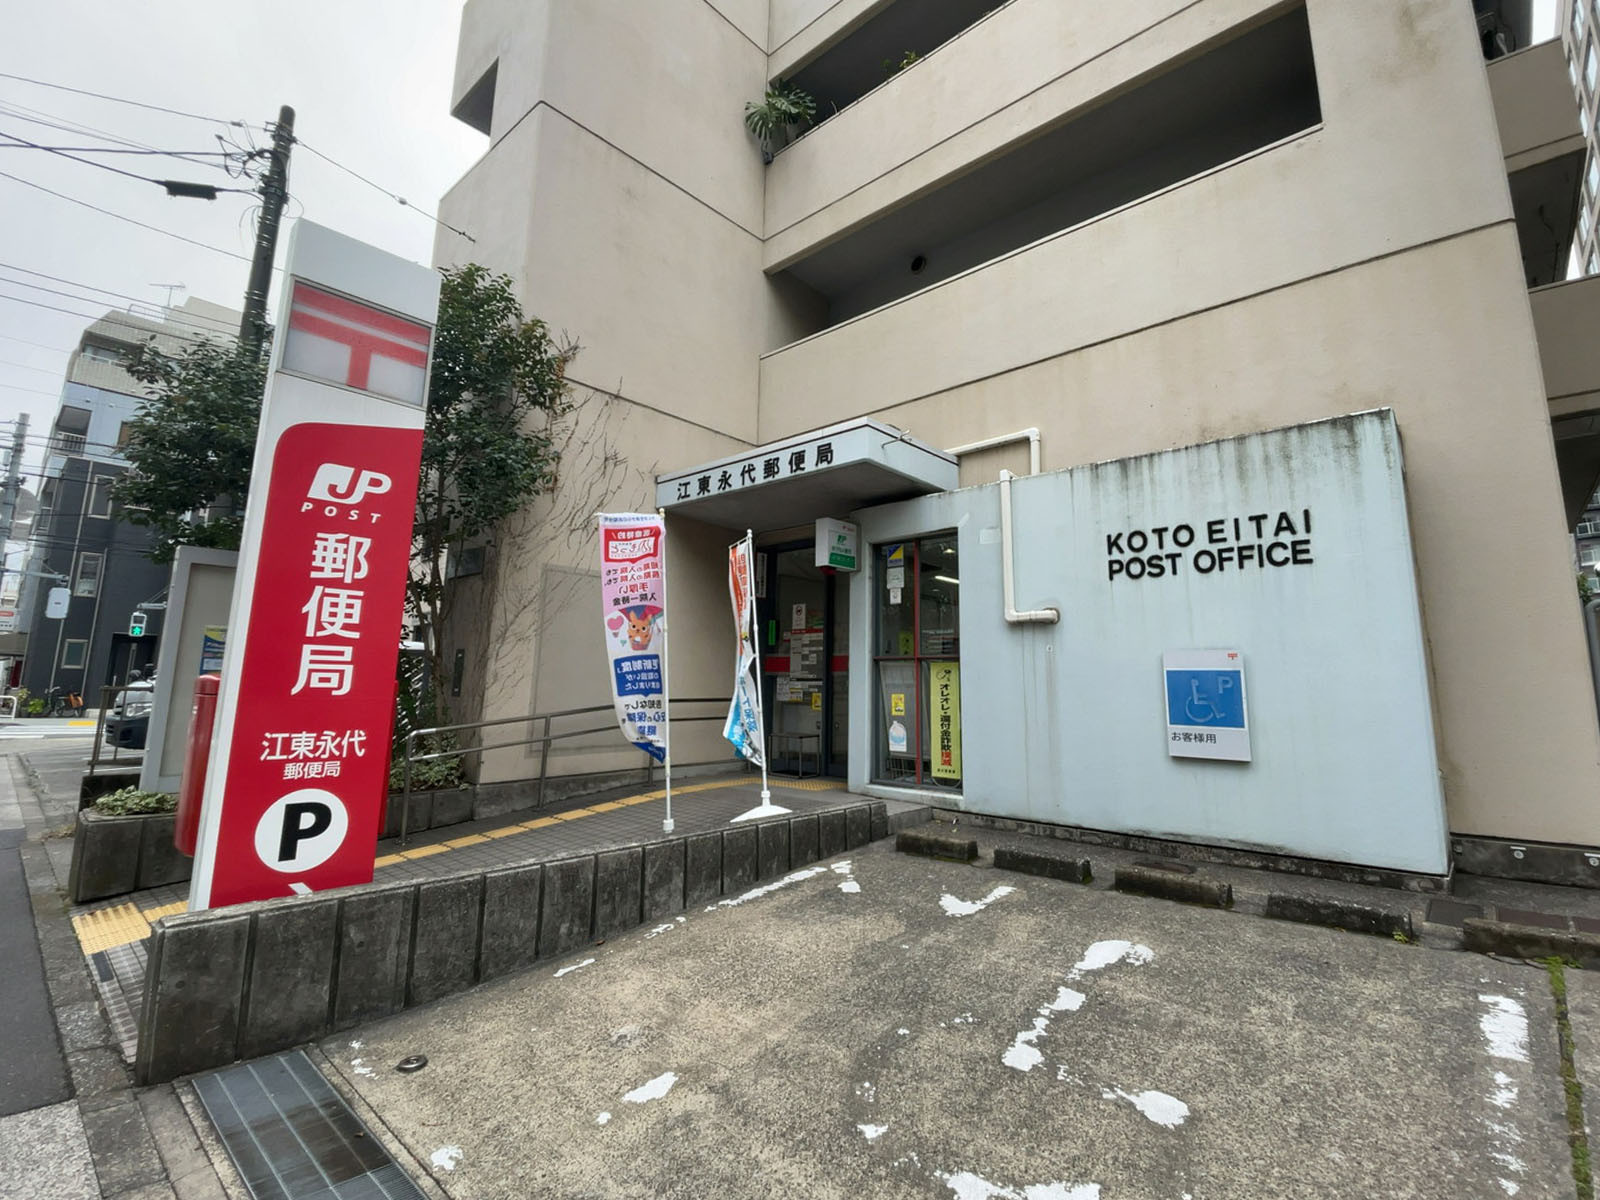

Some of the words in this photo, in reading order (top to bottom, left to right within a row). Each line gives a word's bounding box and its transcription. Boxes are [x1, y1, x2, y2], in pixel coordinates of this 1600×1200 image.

[307, 462, 392, 504] JP
[677, 443, 834, 500] 江東永代郵便局
[301, 502, 381, 524] POST
[1107, 524, 1195, 555] KOTO
[1207, 509, 1312, 544] EITAI
[1108, 553, 1182, 581] POST
[1193, 539, 1314, 575] OFFICE
[291, 532, 371, 696] 郵便局
[1217, 675, 1233, 694] P
[260, 730, 366, 761] 江東永代
[1171, 732, 1217, 744] お客様用
[283, 761, 341, 780] 郵便局
[278, 802, 332, 862] P
